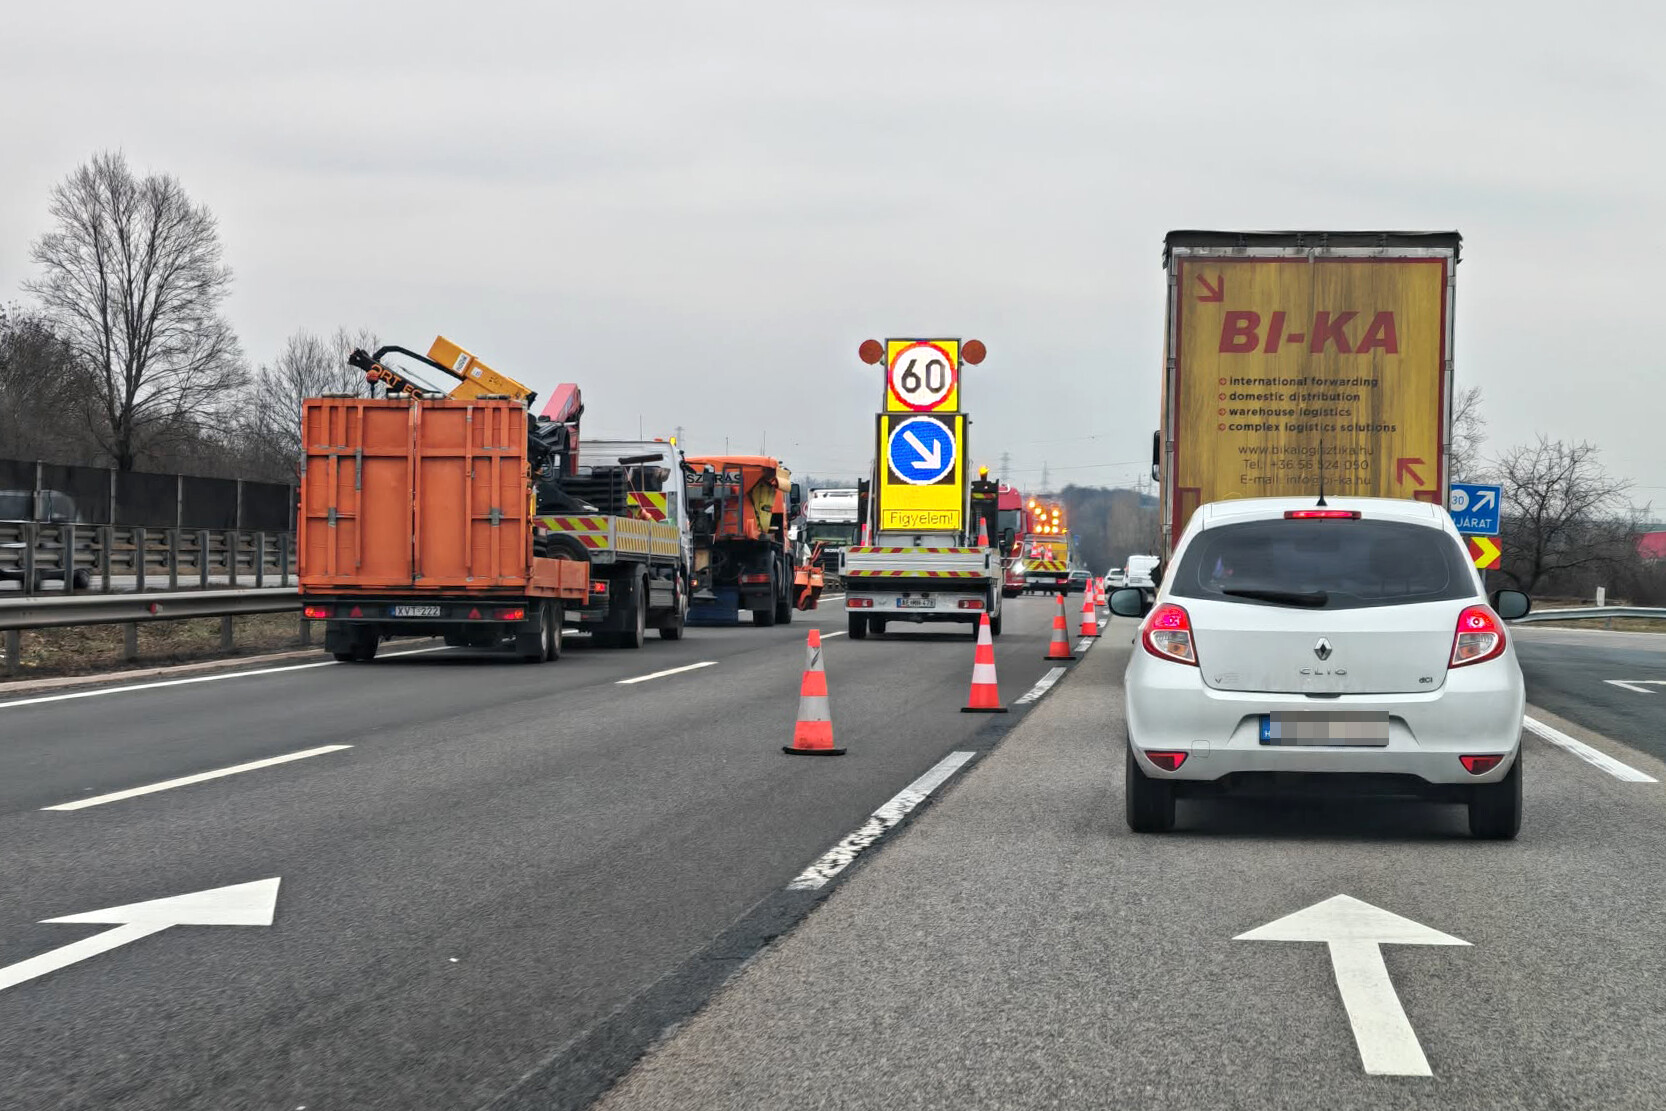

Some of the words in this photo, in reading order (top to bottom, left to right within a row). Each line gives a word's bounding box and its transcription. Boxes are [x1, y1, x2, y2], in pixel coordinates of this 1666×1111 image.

[1219, 311, 1399, 354] BI-KA
[901, 358, 946, 394] 60
[1229, 376, 1307, 386] international
[1311, 376, 1379, 388] forwarding
[1229, 391, 1285, 401] domestic
[1289, 391, 1361, 402] distribution
[1229, 406, 1295, 416] warehouse
[1300, 406, 1352, 417] logistics
[1229, 421, 1280, 433] complex
[1285, 421, 1337, 433] logistics
[1340, 422, 1397, 433] solutions
[686, 472, 741, 484] SZRÁS
[1452, 495, 1465, 505] 30
[890, 511, 953, 527] Figyelem!
[1300, 668, 1347, 676] CLIO
